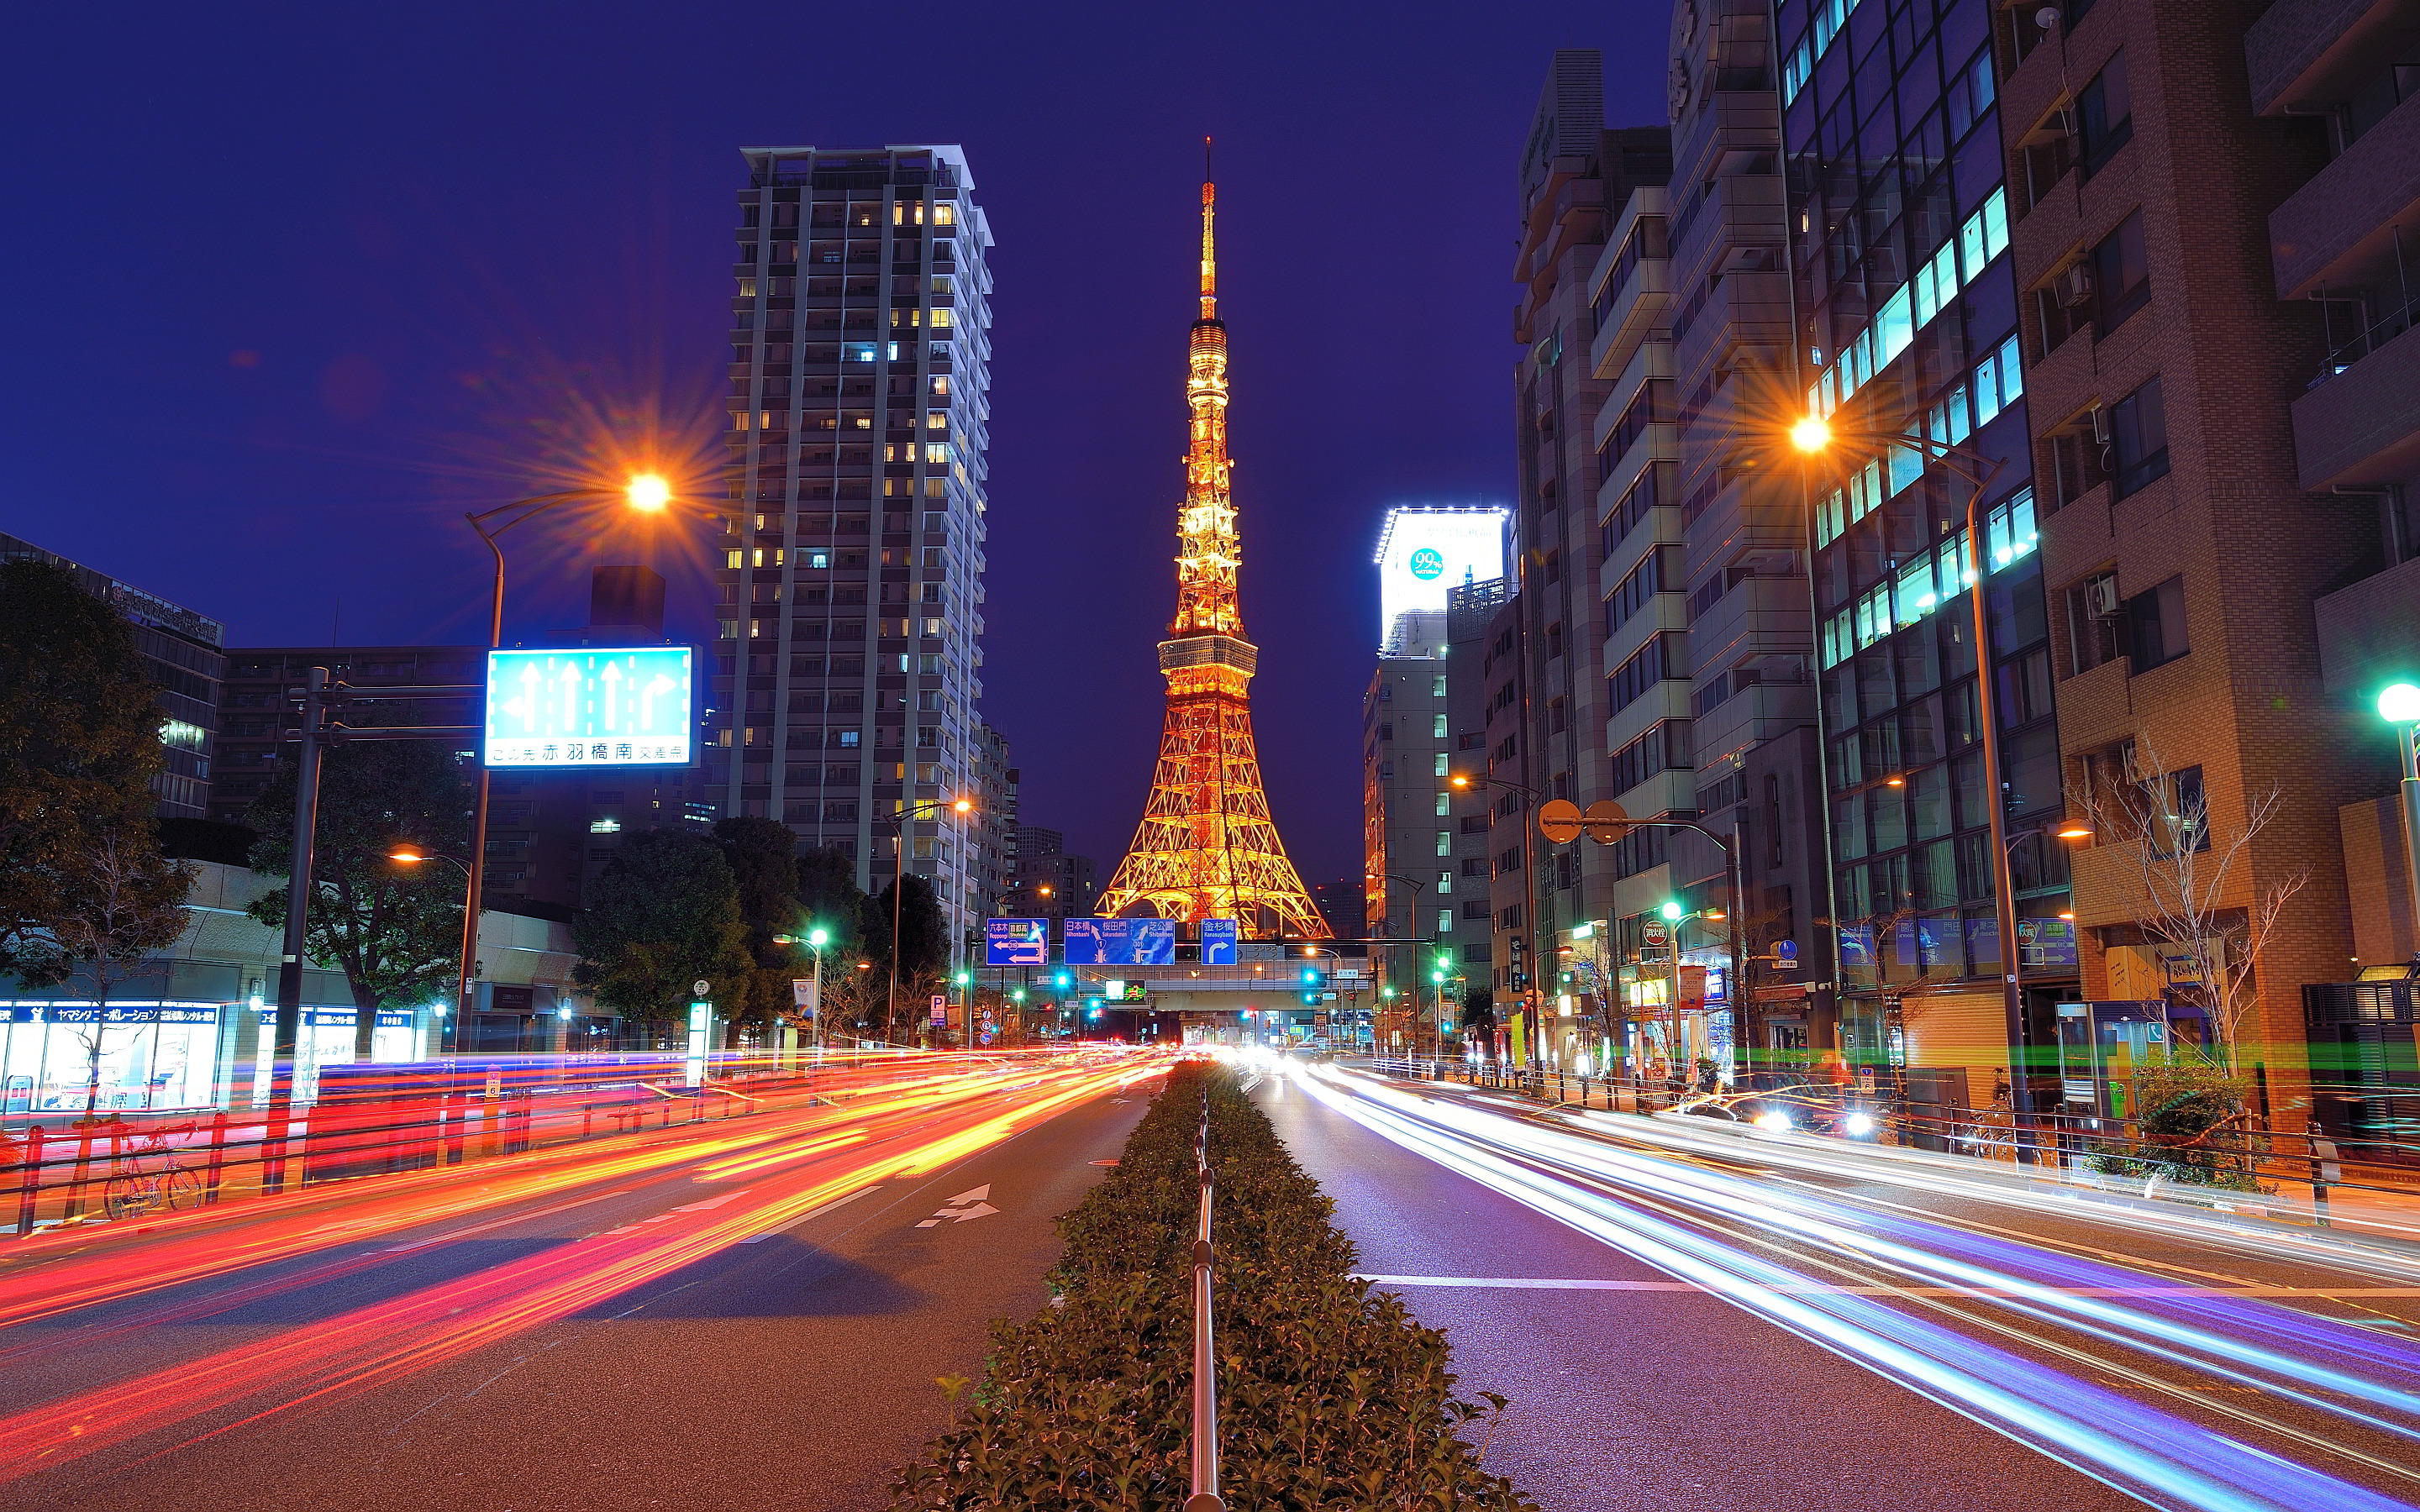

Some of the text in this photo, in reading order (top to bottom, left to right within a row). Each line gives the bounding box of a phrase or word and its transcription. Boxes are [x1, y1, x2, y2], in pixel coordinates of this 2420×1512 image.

[1415, 552, 1442, 569] 99%
[989, 923, 1008, 932] 六本木
[1066, 921, 1090, 931] 日本橋
[1102, 921, 1127, 931] 桜田門
[1149, 921, 1173, 931] 芝公園
[1204, 921, 1234, 931] 金杉橋
[1646, 928, 1665, 937] 消火栓
[934, 998, 943, 1008] P
